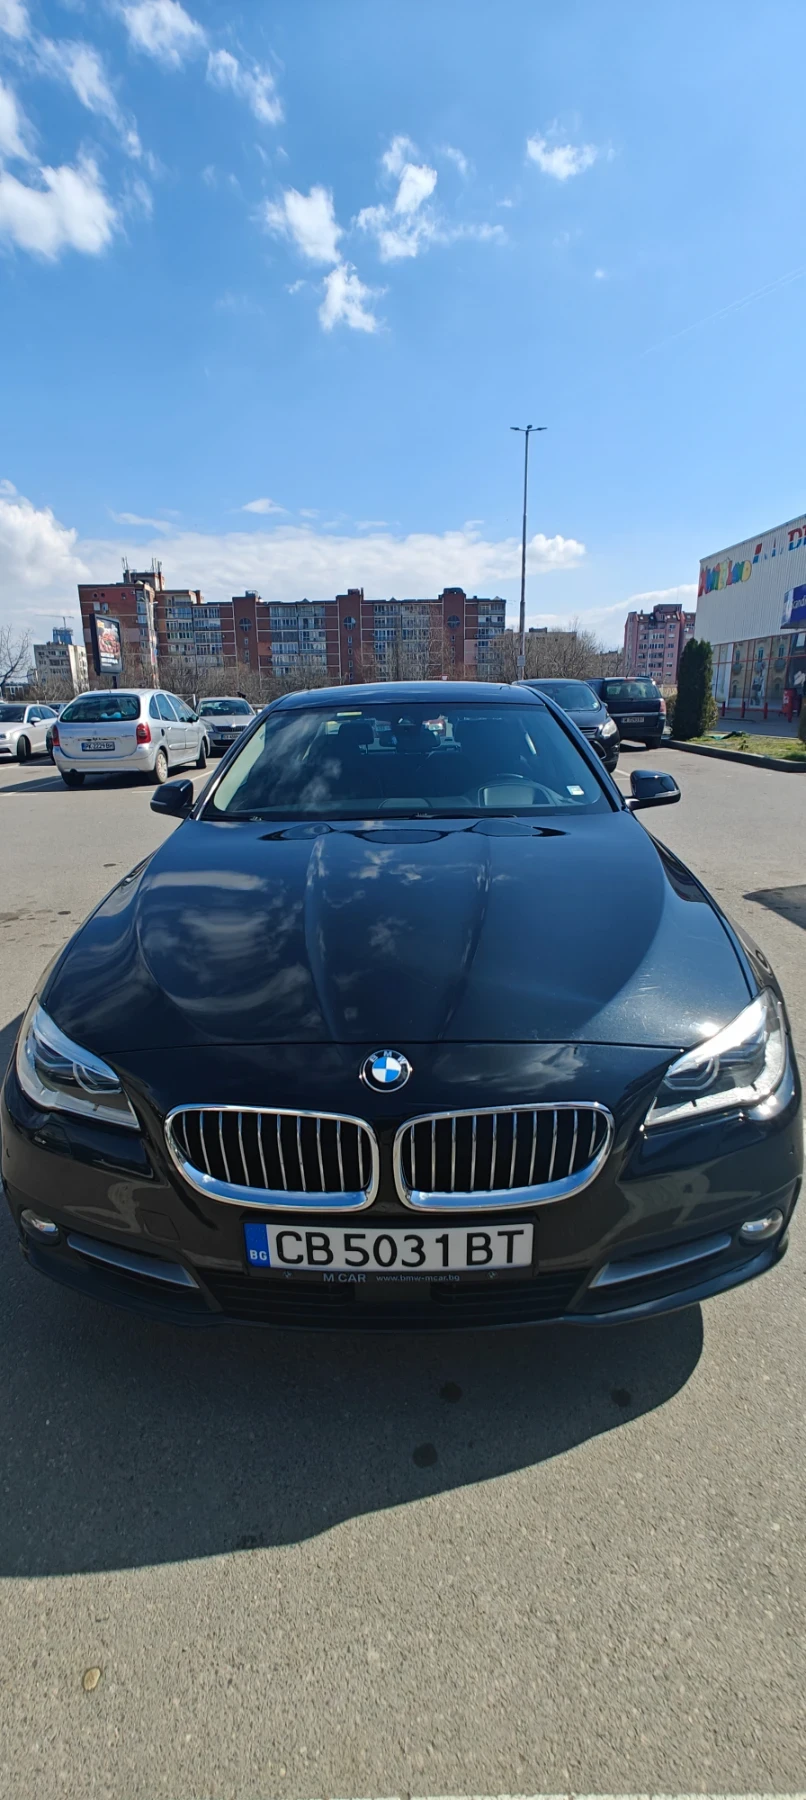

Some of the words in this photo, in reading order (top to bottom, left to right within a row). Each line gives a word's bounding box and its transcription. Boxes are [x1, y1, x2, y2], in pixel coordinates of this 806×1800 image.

[369, 1050, 407, 1064] BMW
[275, 1230, 334, 1266] CB
[343, 1233, 450, 1268] 5031
[466, 1229, 525, 1266] BT
[250, 1250, 267, 1261] BG
[323, 1273, 334, 1283] M
[338, 1273, 367, 1283] CAR
[375, 1274, 460, 1283] www.bmw-mcar.bg
